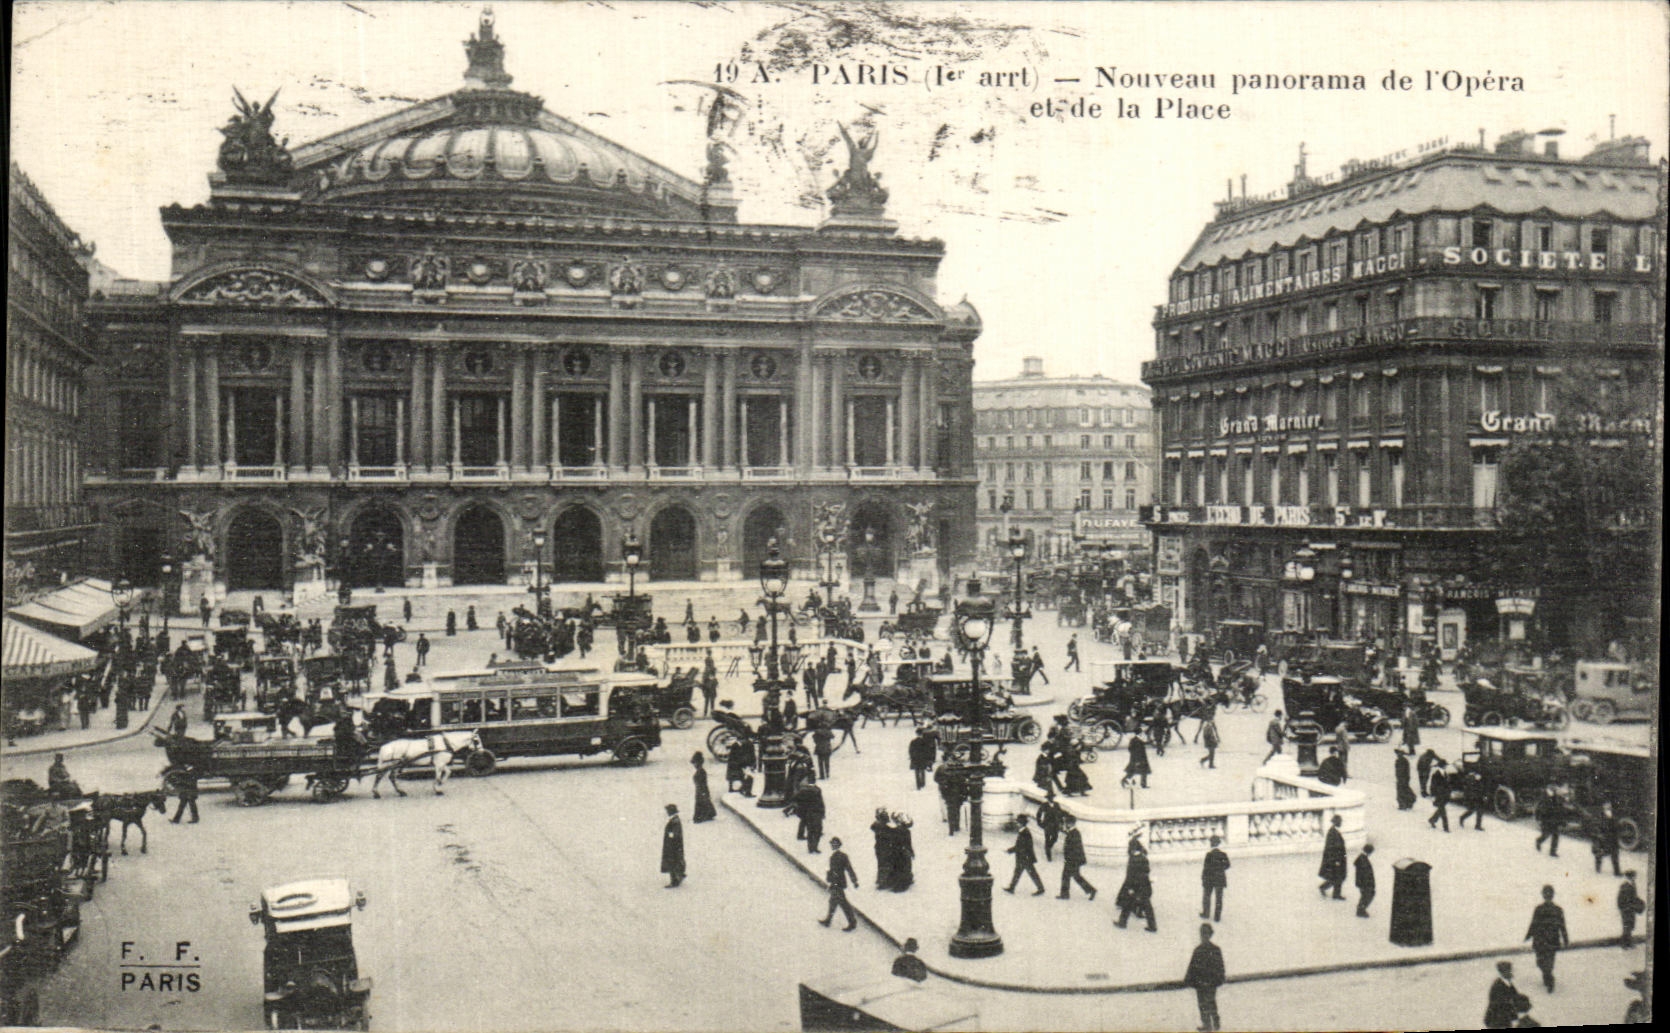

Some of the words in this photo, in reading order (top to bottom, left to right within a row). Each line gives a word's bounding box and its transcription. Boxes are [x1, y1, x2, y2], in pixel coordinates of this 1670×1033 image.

[1443, 246, 1607, 270] SOCIETE
[1161, 293, 1221, 319] PRODUITS
[1232, 265, 1342, 304] ALIMENTAIRES
[1352, 252, 1406, 279] MAGGI
[1219, 414, 1259, 438] Grand
[1262, 414, 1321, 432] Marnier
[1480, 410, 1557, 433] Grand
[1273, 506, 1311, 527] PARIS
